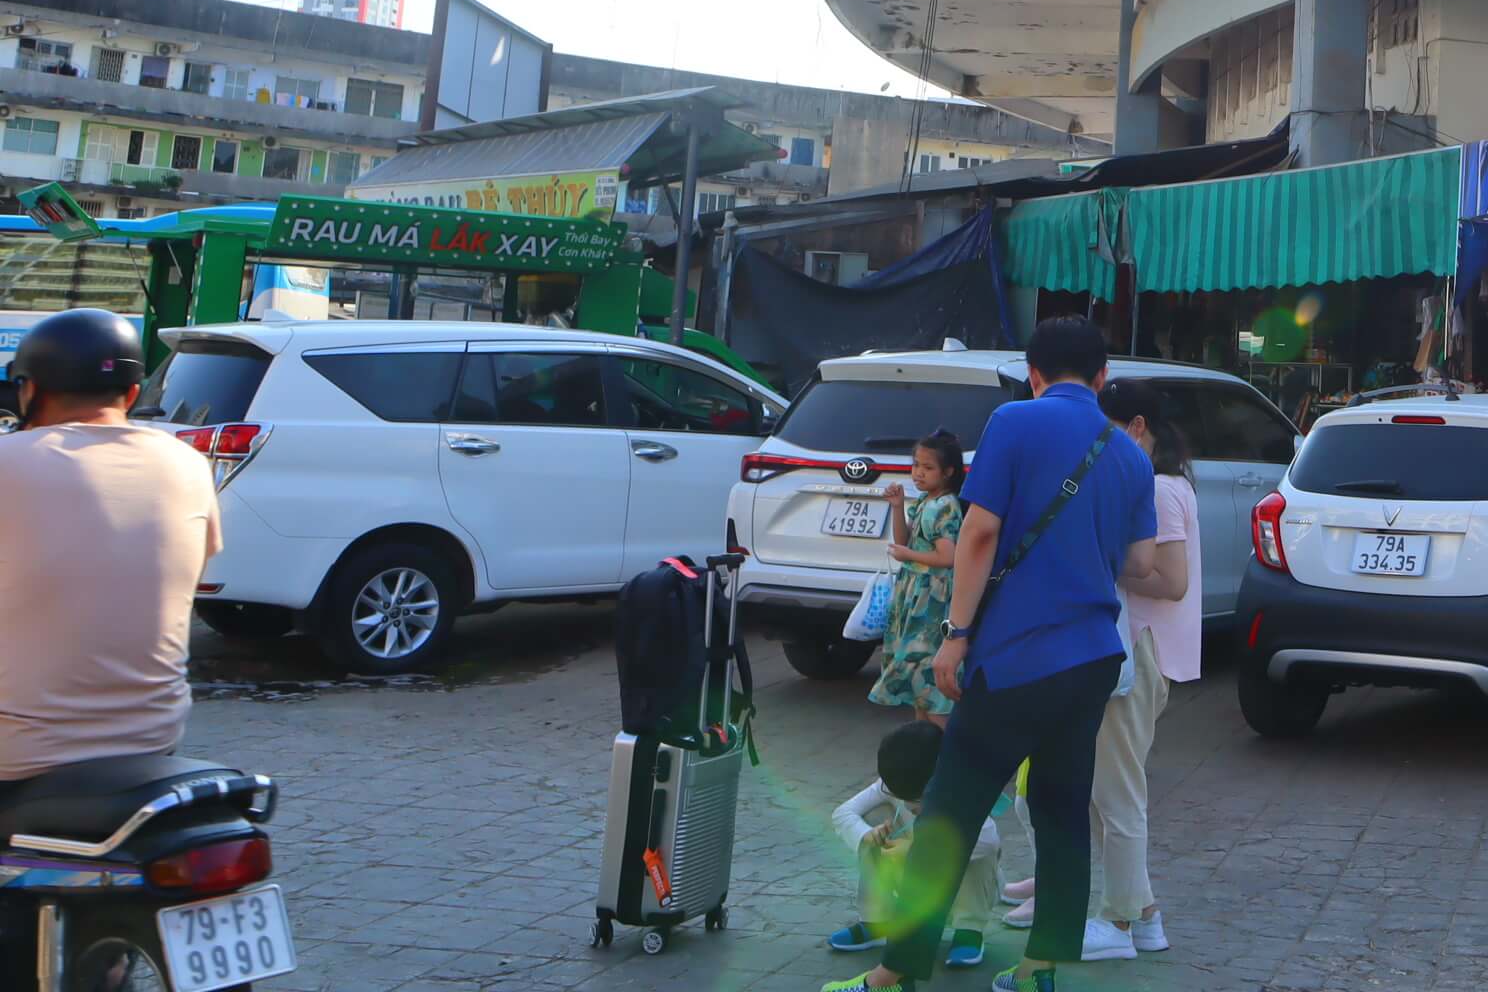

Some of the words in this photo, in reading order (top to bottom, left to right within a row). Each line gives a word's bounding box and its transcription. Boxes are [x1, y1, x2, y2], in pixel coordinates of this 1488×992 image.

[290, 218, 364, 244] RAU
[368, 222, 420, 249] MÁ
[494, 234, 558, 257] XAY
[590, 234, 611, 247] Bay
[845, 501, 869, 517] 79A
[829, 518, 876, 535] 419.92
[1376, 536, 1405, 553] 79A
[1358, 554, 1417, 572] 334.35
[179, 896, 267, 945] 79-F3
[187, 936, 276, 985] 9990
